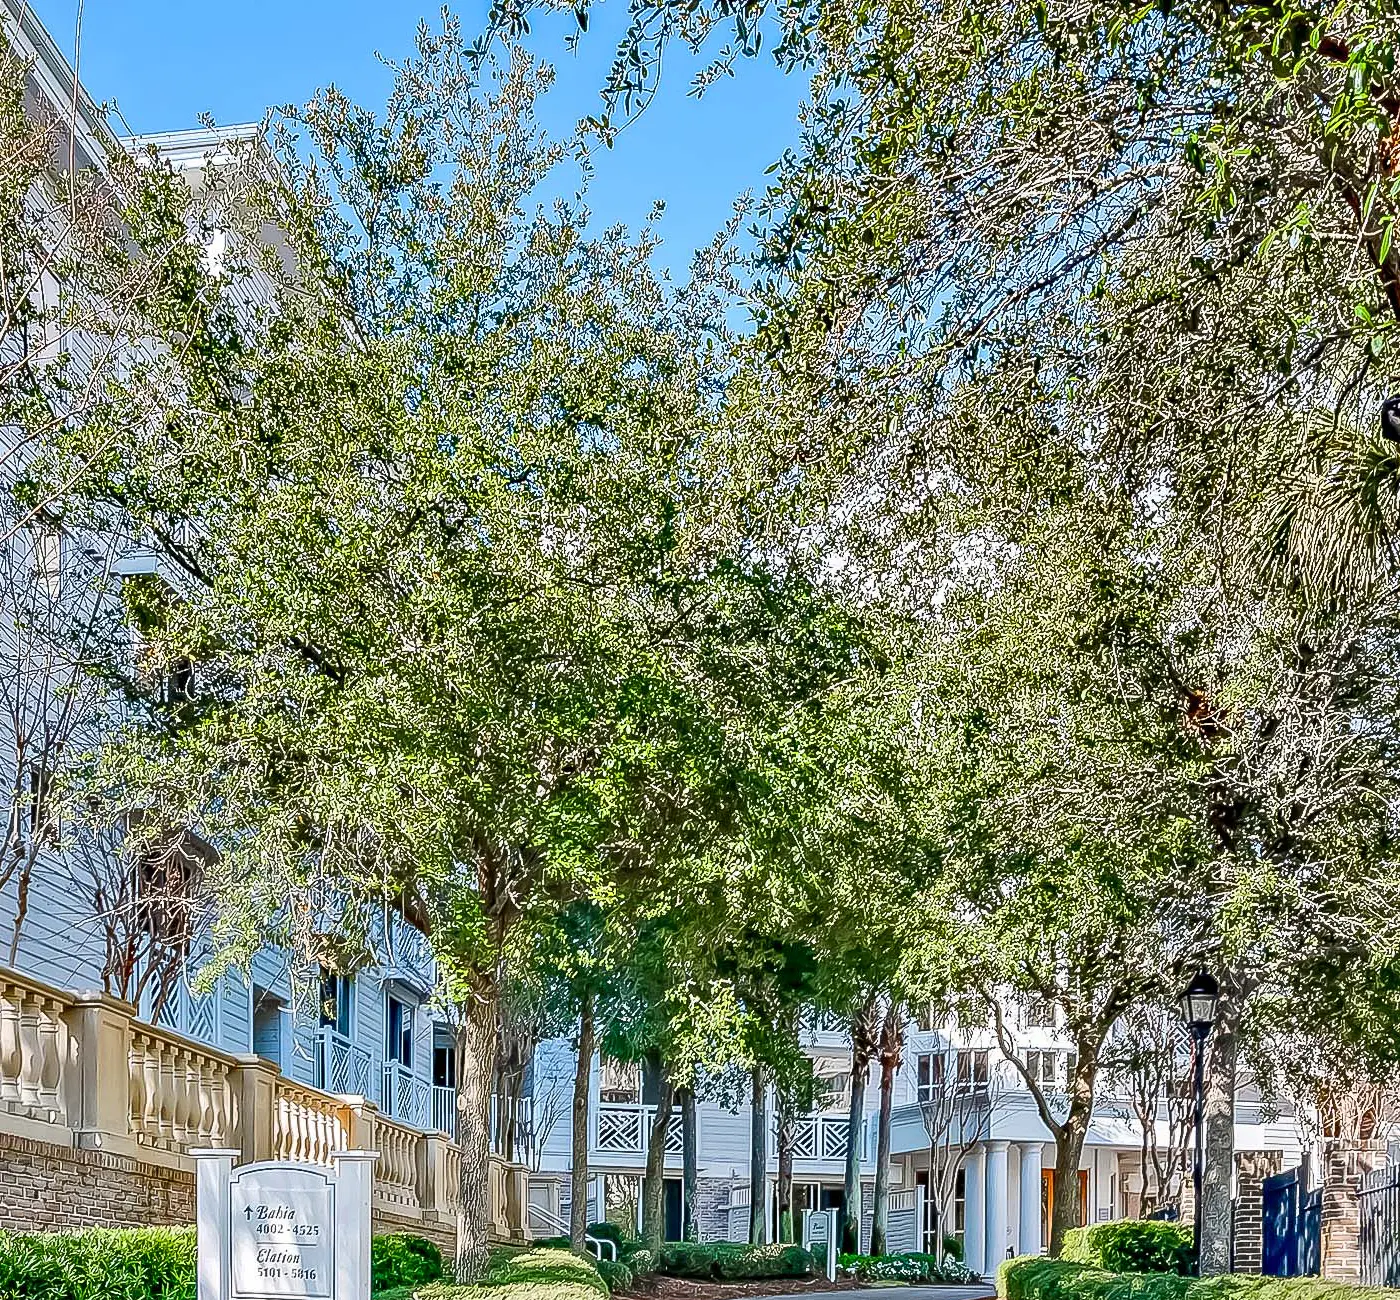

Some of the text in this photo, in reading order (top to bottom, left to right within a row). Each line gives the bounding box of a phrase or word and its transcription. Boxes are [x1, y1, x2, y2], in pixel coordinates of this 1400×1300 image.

[256, 1205, 295, 1220] Bahia
[256, 1223, 284, 1234] 4002
[292, 1224, 319, 1236] 4525
[256, 1248, 300, 1264] Elation
[257, 1267, 281, 1278] 5101
[291, 1268, 316, 1280] 5816
